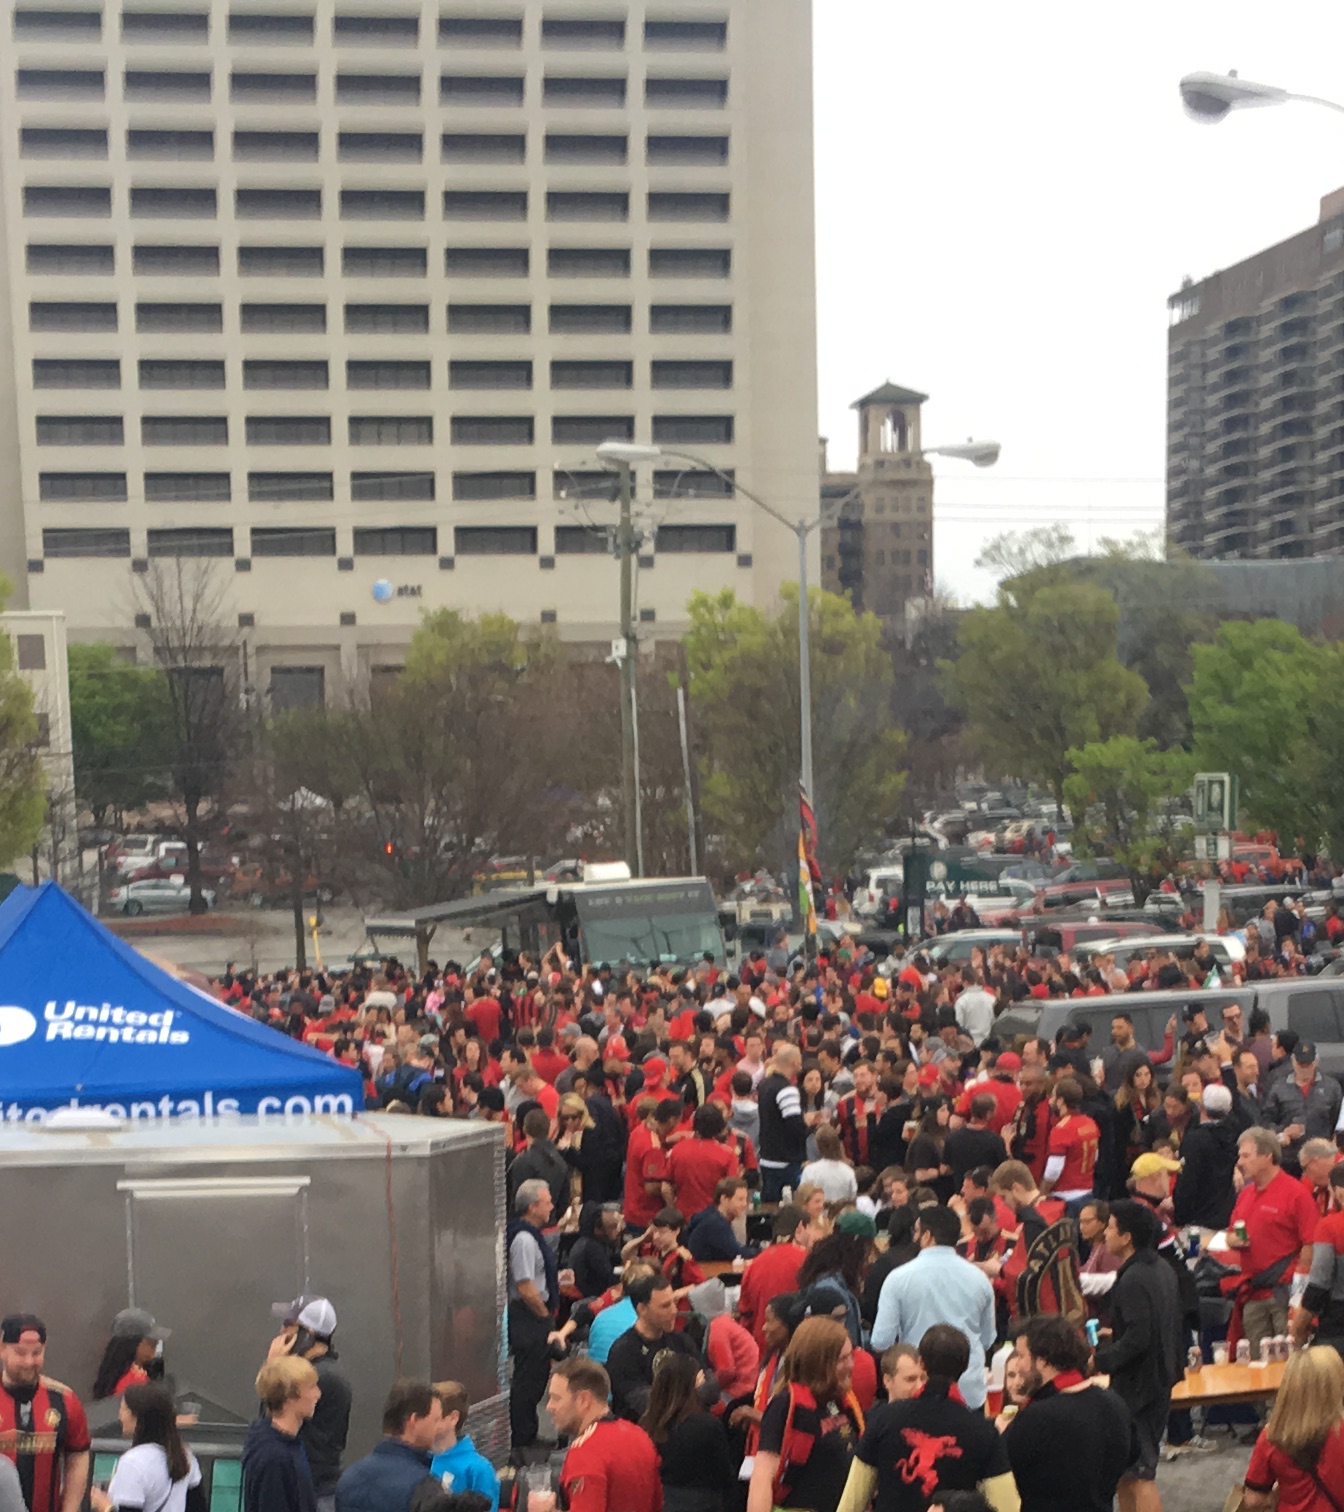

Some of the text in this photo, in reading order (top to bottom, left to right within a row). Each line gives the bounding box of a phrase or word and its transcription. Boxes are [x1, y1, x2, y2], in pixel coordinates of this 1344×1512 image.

[926, 880, 956, 894] PAY
[44, 1000, 175, 1027] United
[46, 1020, 190, 1045] Rentals
